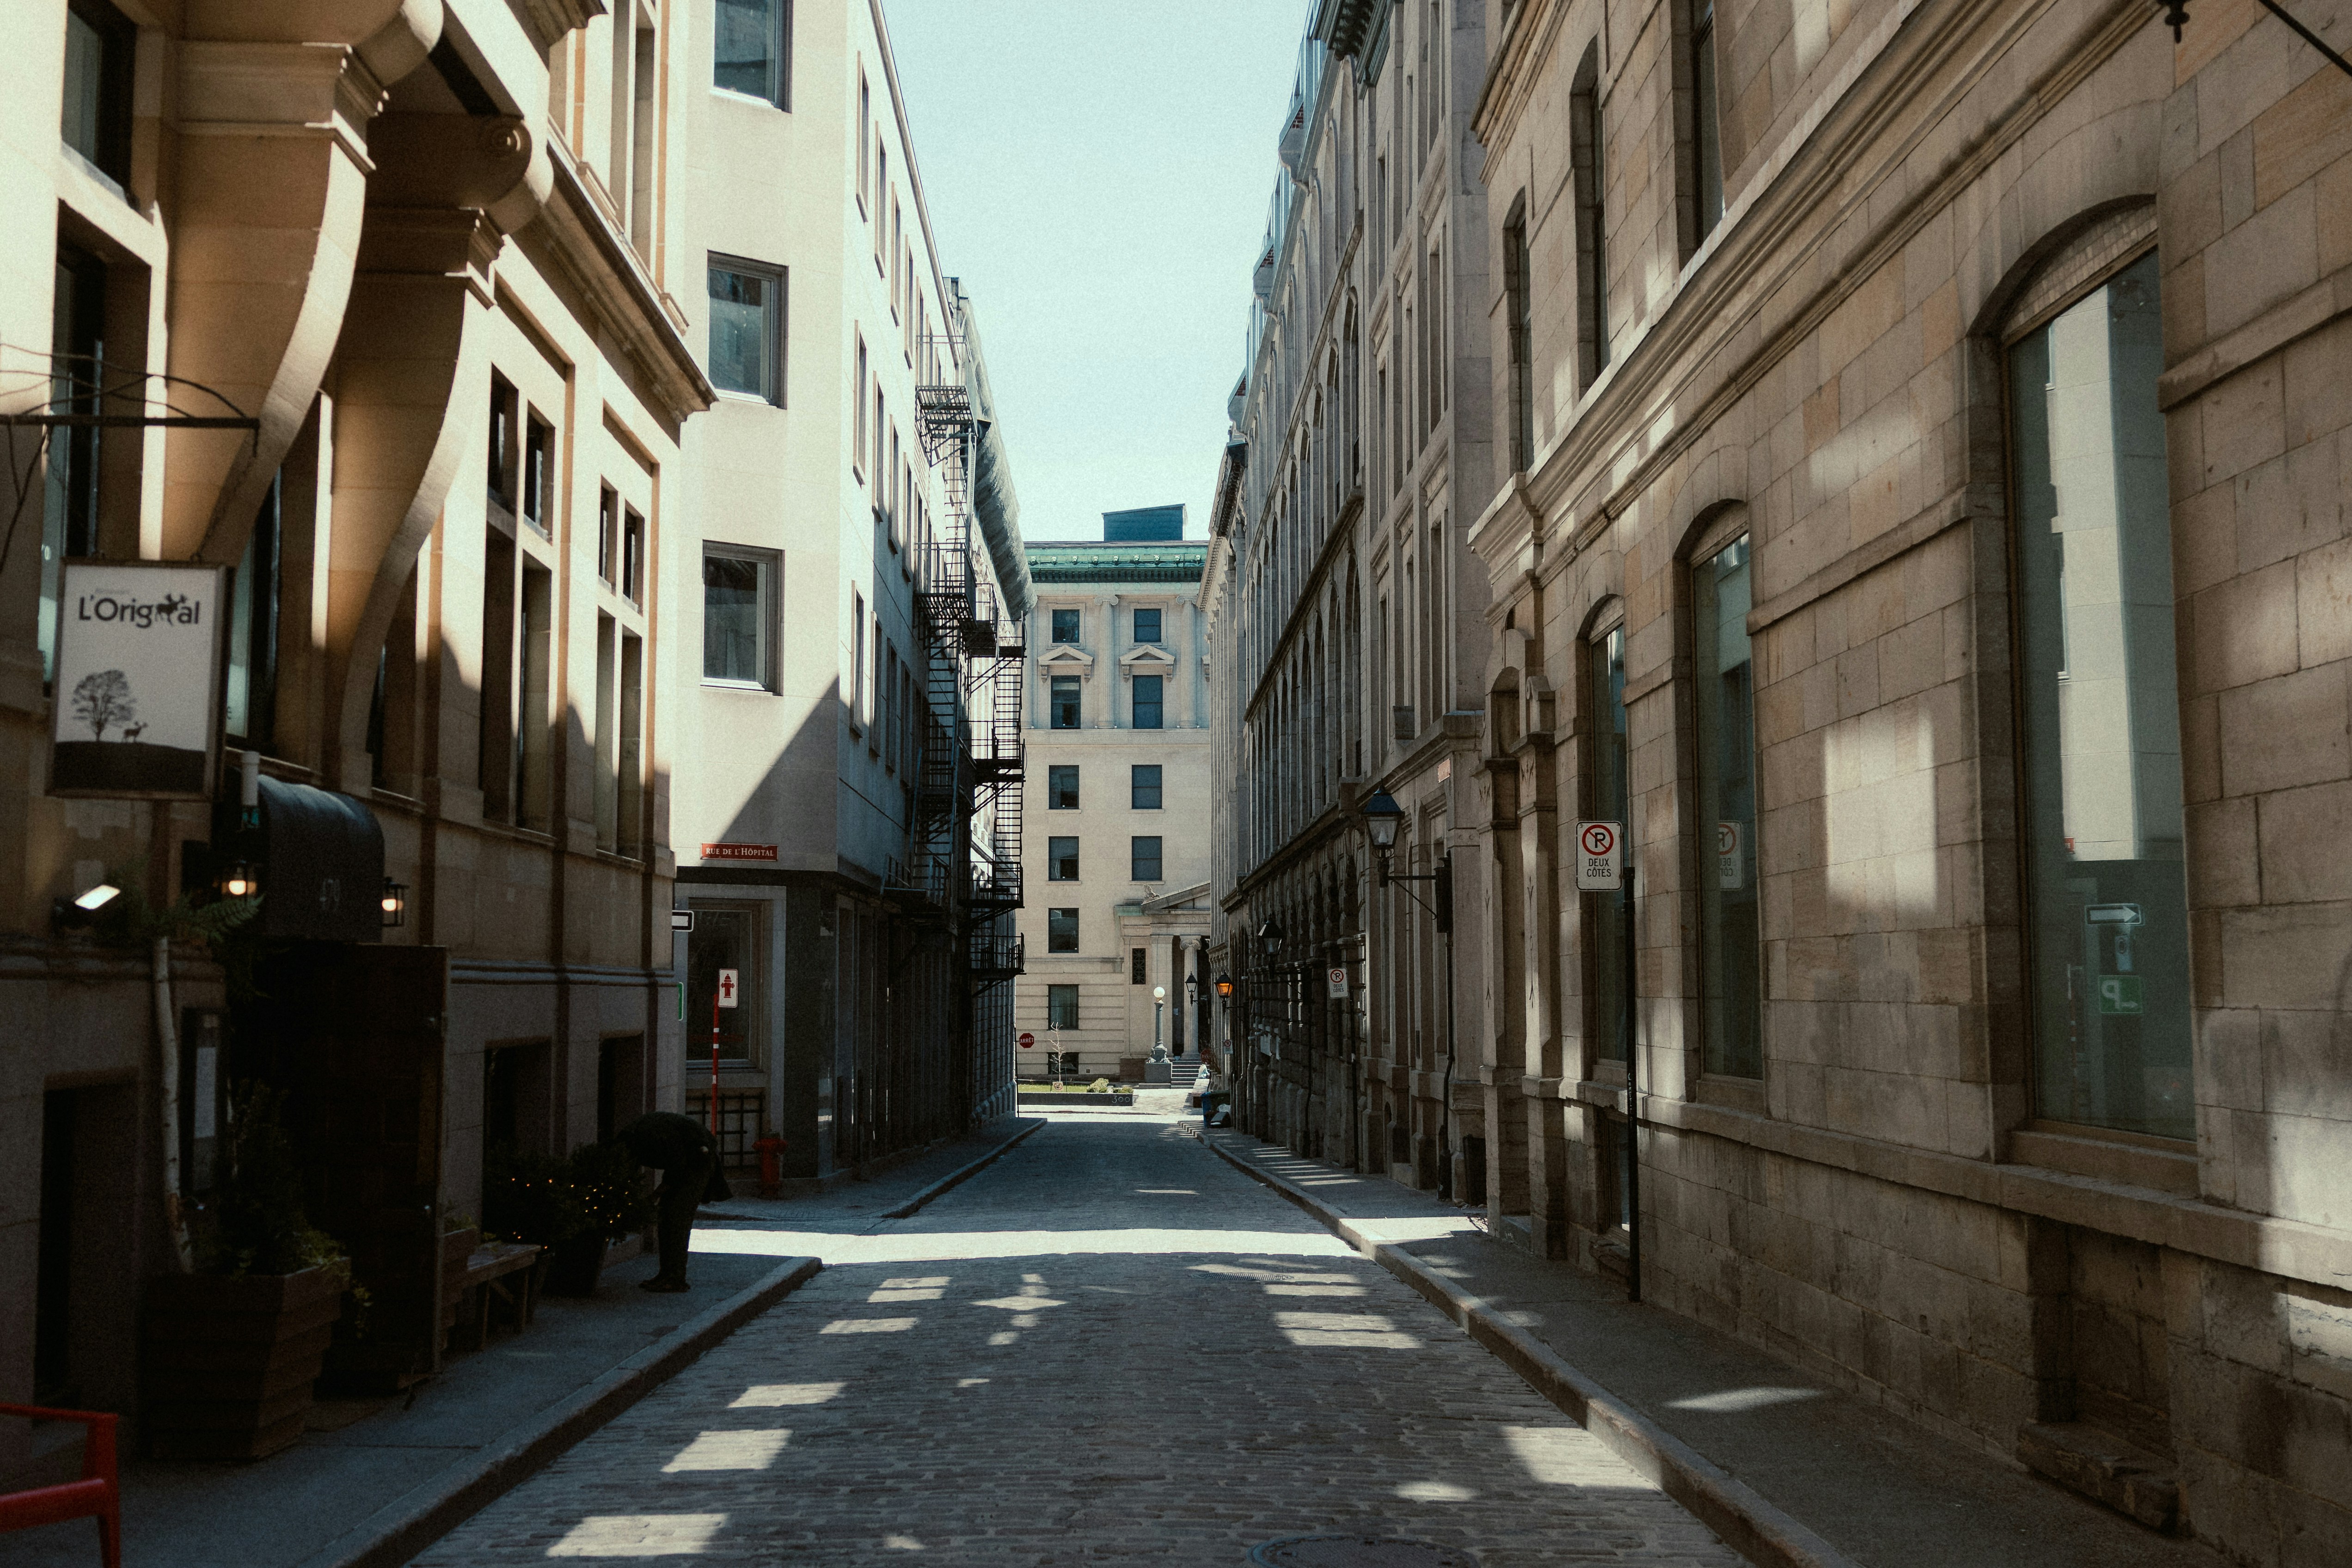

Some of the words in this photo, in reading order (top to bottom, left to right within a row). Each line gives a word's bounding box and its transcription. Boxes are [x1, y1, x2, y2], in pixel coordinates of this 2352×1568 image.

[735, 848, 773, 856] L'HÔPITAL
[1588, 858, 1609, 867] DEUX
[1586, 867, 1611, 877] CÔTÉS
[1111, 1095, 1130, 1103] 300
